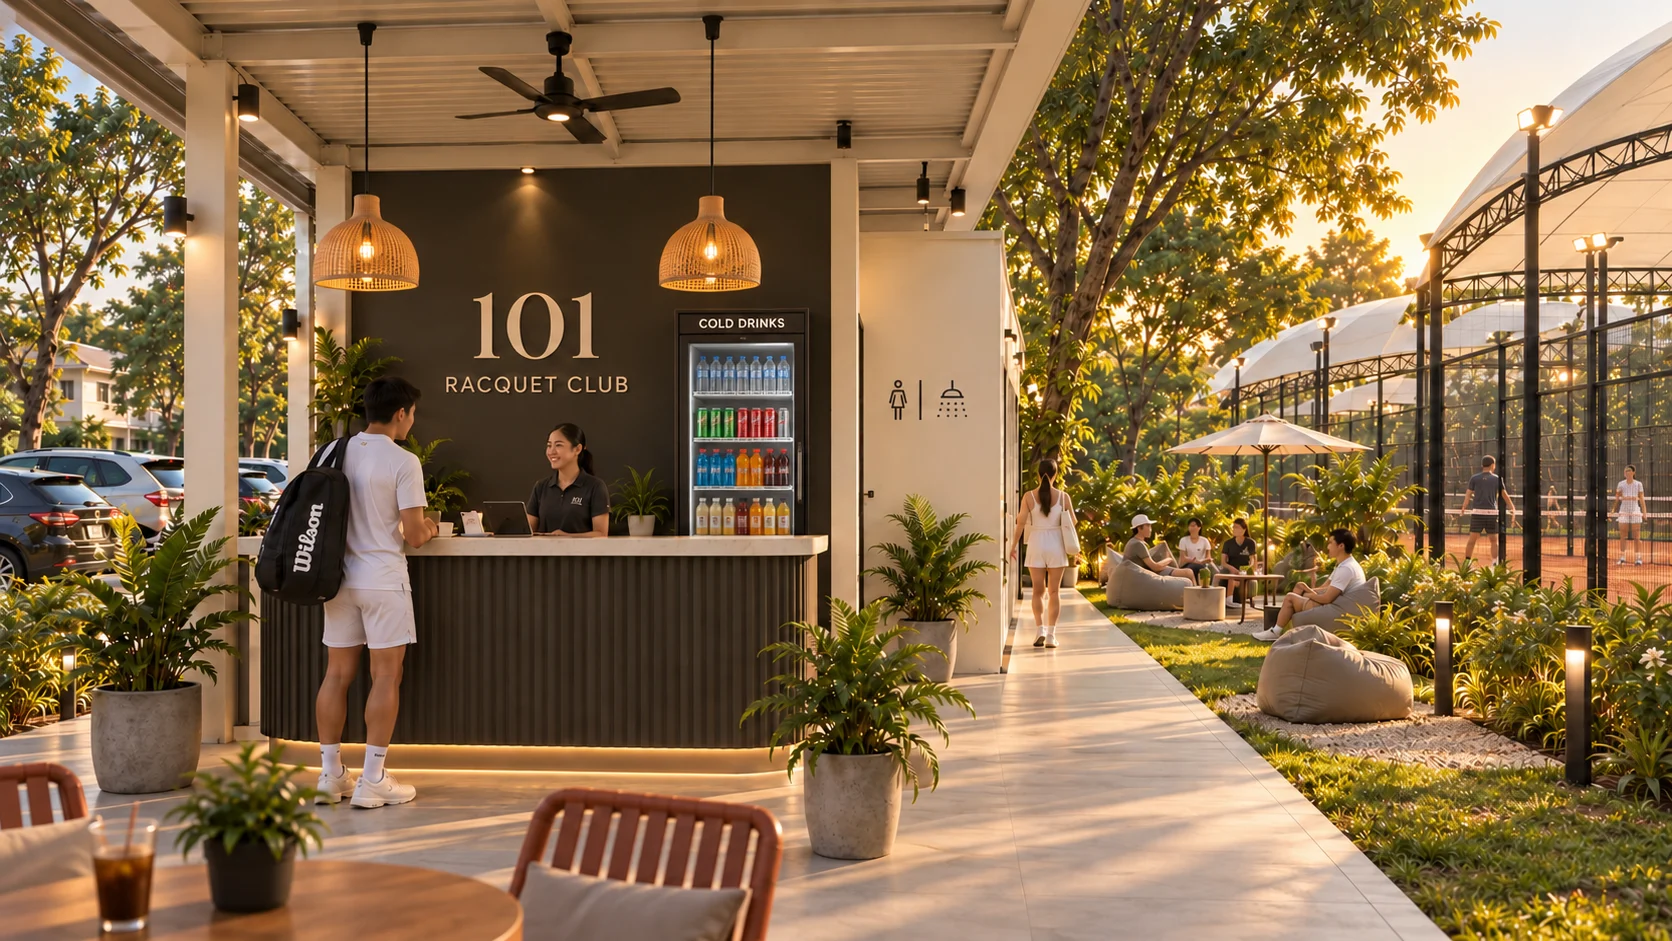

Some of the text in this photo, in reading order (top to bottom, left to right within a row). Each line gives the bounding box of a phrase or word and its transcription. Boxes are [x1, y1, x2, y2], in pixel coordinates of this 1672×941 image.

[472, 292, 600, 360] 101
[698, 317, 785, 329] COLD DRINKS
[445, 376, 629, 394] RACQUET CLUB
[293, 503, 324, 572] Wilson
